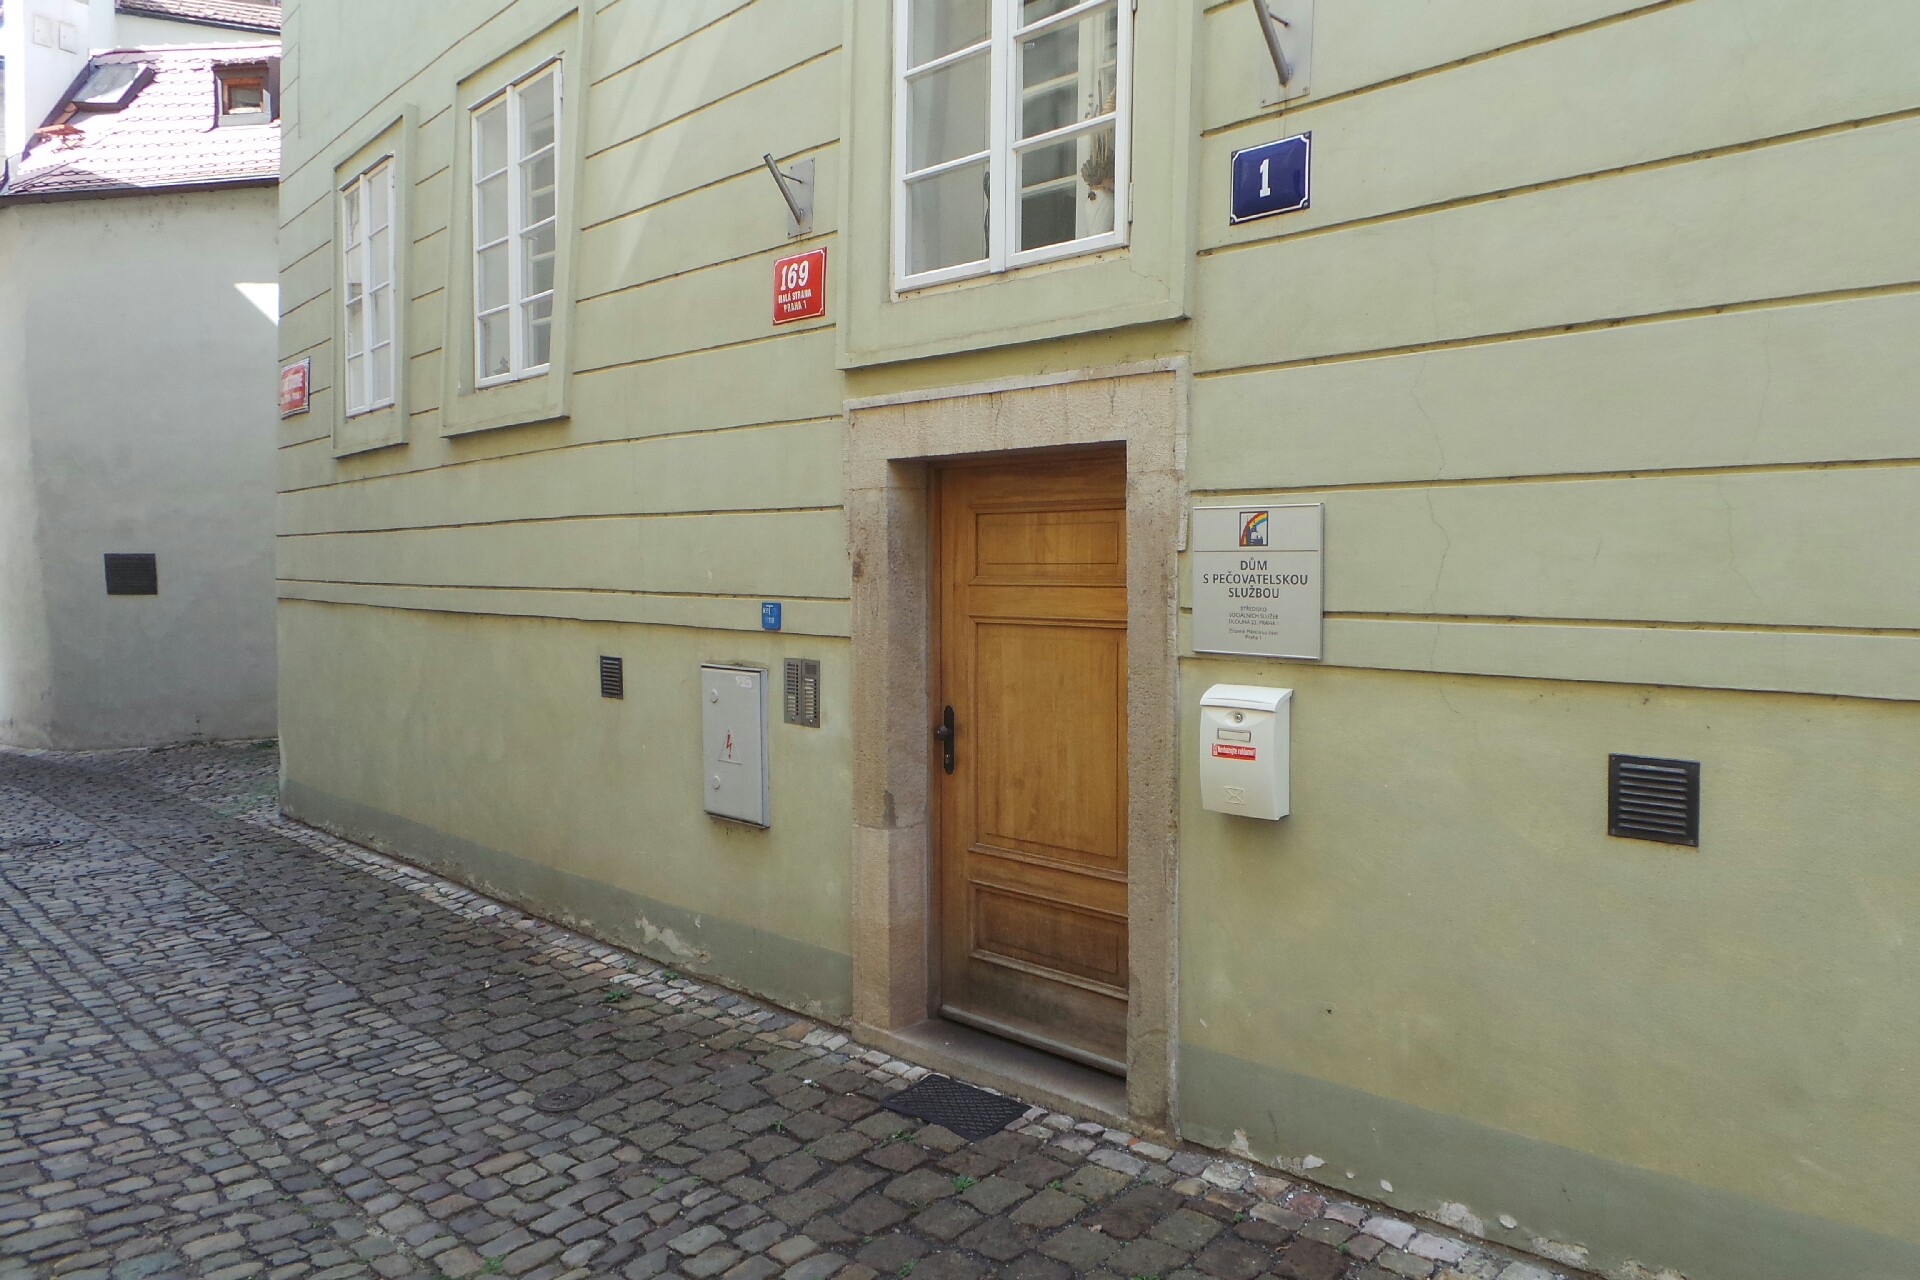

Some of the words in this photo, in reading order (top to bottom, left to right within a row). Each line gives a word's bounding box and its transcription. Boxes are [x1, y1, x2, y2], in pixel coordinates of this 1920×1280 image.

[1259, 158, 1271, 198] 1
[780, 260, 809, 291] 169
[792, 288, 812, 300] STRANA
[783, 300, 802, 313] PRAHA
[803, 299, 807, 309] 1
[1240, 556, 1268, 571] DŮM
[1203, 573, 1209, 584] S
[1212, 571, 1308, 585] PEČOVATELSKOU
[1228, 585, 1280, 599] SLUŽBOU
